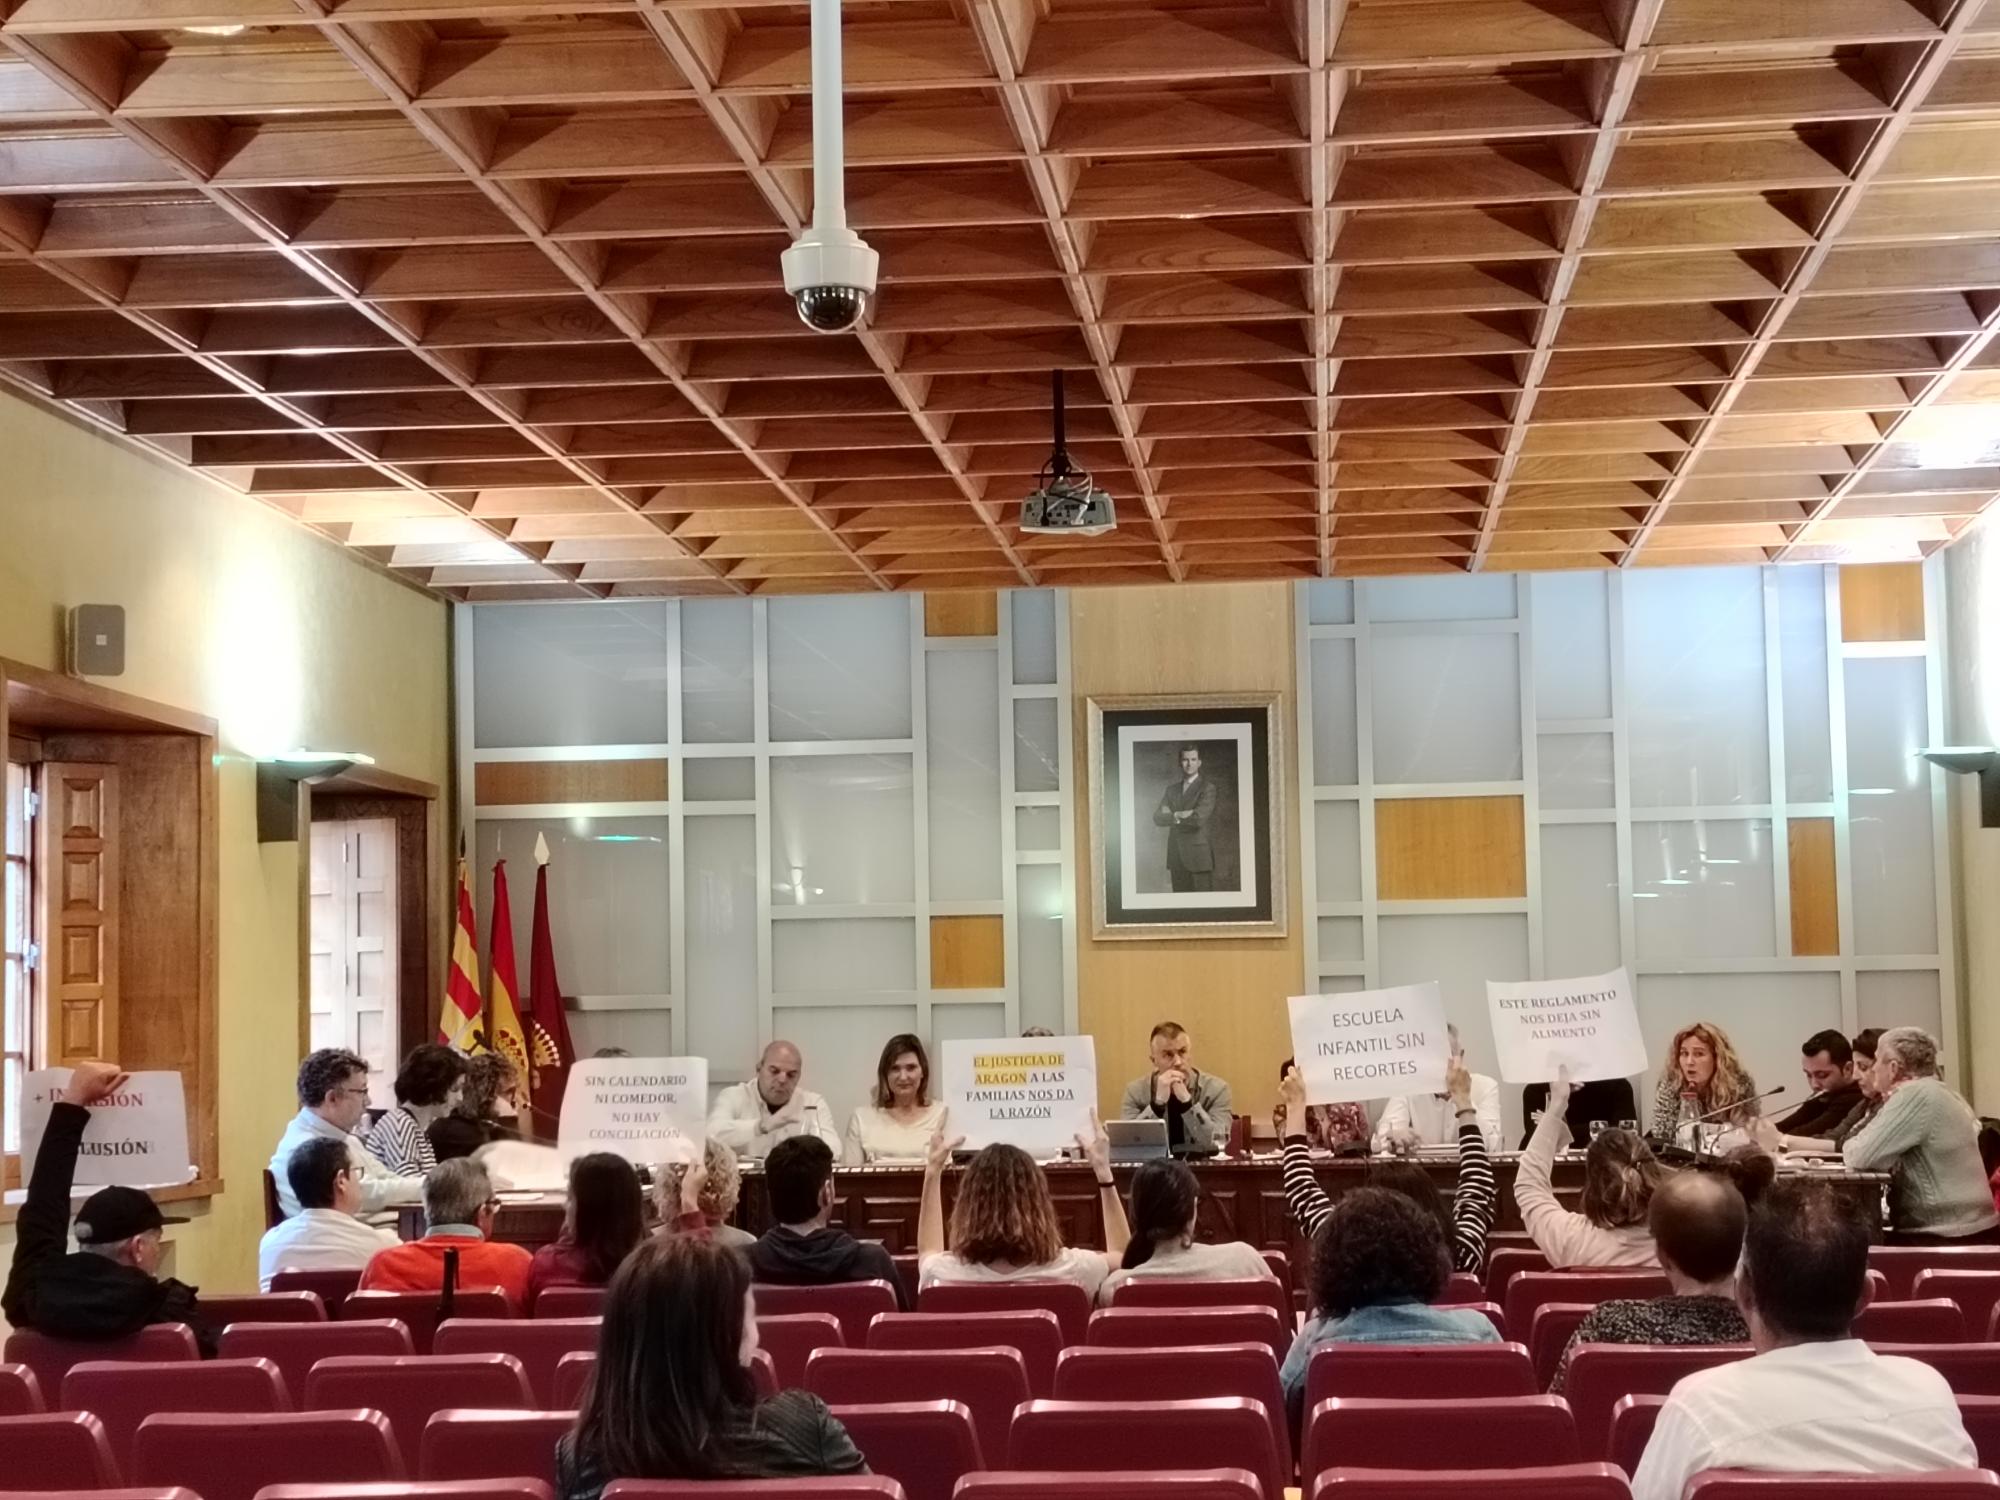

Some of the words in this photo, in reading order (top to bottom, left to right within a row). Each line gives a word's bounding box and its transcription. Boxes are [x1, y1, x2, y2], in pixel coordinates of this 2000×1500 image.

[1499, 999, 1527, 1009] ESTE
[1531, 989, 1616, 1009] REGLAMENTO
[1333, 1008, 1404, 1028] ESCUELA
[1520, 1014, 1544, 1024] NOS
[1547, 1012, 1577, 1024] DEJA
[1580, 1009, 1600, 1020] SIN
[1531, 1026, 1596, 1040] ALIMENTO
[1318, 1038, 1392, 1057] INFANTIL
[1396, 1032, 1425, 1049] SIN
[974, 1057, 989, 1068] EL
[991, 1055, 1045, 1068] JUSTICIA
[1048, 1054, 1065, 1065] DE
[1030, 1073, 1039, 1083] A
[1042, 1072, 1065, 1083] LAS
[1333, 1060, 1417, 1081] RECORTES
[585, 1075, 606, 1087] SIN
[609, 1075, 687, 1087] CALENDARIO
[595, 1093, 609, 1104] NI
[966, 1091, 1025, 1102] FAMILIAS
[1028, 1090, 1053, 1101] NOS
[1056, 1089, 1074, 1100] DA
[612, 1112, 631, 1123] NO
[634, 1112, 661, 1123] HAY
[989, 1108, 1005, 1119] LA
[1008, 1105, 1051, 1119] RAZÓN
[589, 1128, 681, 1140] CONCILIACIÓN
